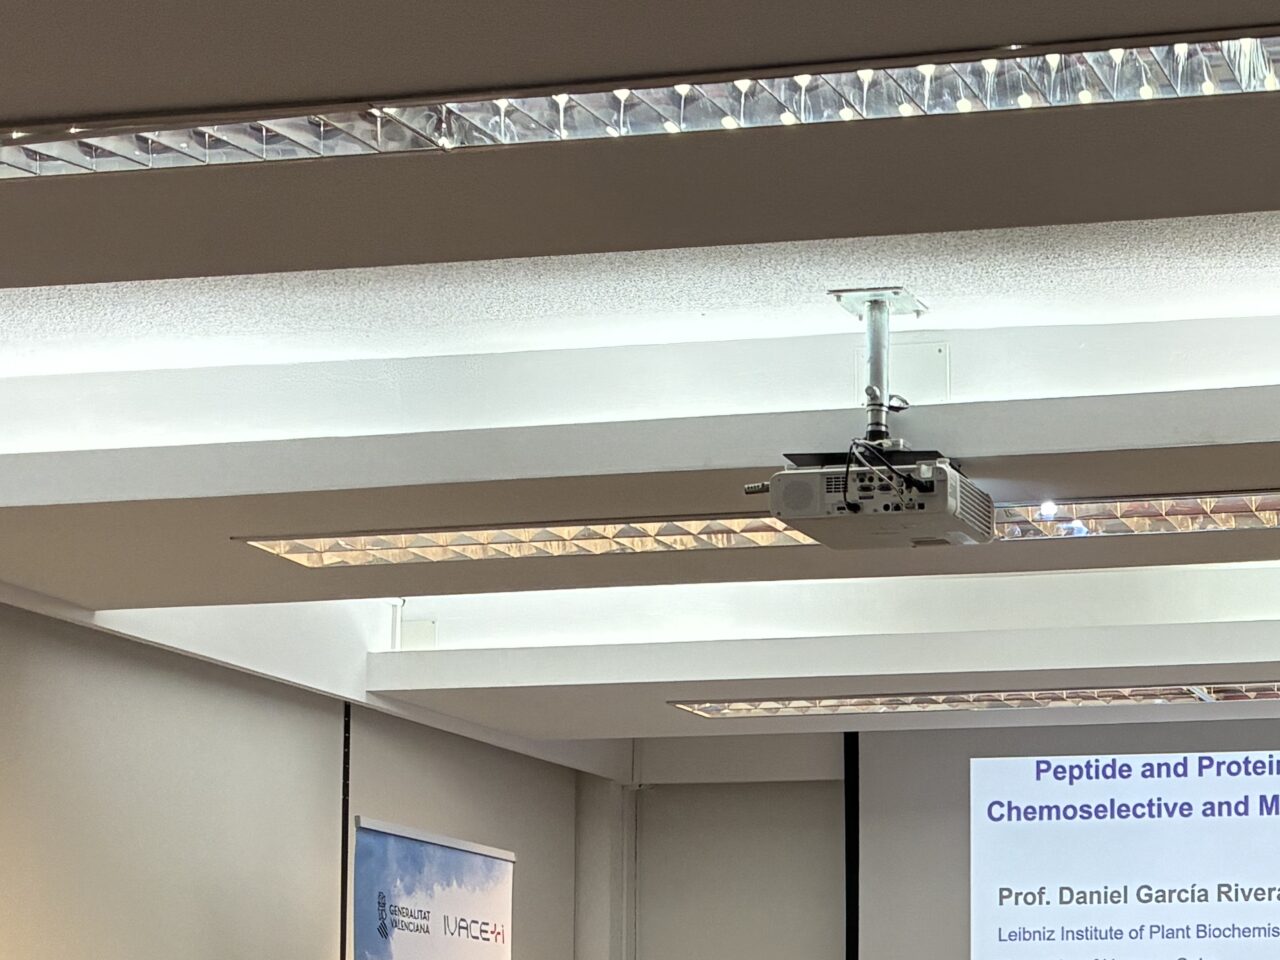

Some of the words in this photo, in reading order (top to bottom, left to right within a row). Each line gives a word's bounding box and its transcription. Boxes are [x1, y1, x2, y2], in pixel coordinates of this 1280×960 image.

[1036, 758, 1132, 785] Peptide
[1141, 757, 1188, 778] and
[987, 798, 1193, 822] Chemoselective
[1202, 795, 1249, 818] and
[998, 887, 1051, 906] Prof.
[1059, 885, 1128, 905] Daniel
[1136, 883, 1209, 904] García
[389, 904, 431, 922] GENERALITAT
[390, 919, 431, 935] VALENCIANA
[998, 926, 1055, 942] Leibniz
[1061, 925, 1124, 941] Institute
[1128, 925, 1146, 940] of
[1150, 924, 1191, 940] Plant
